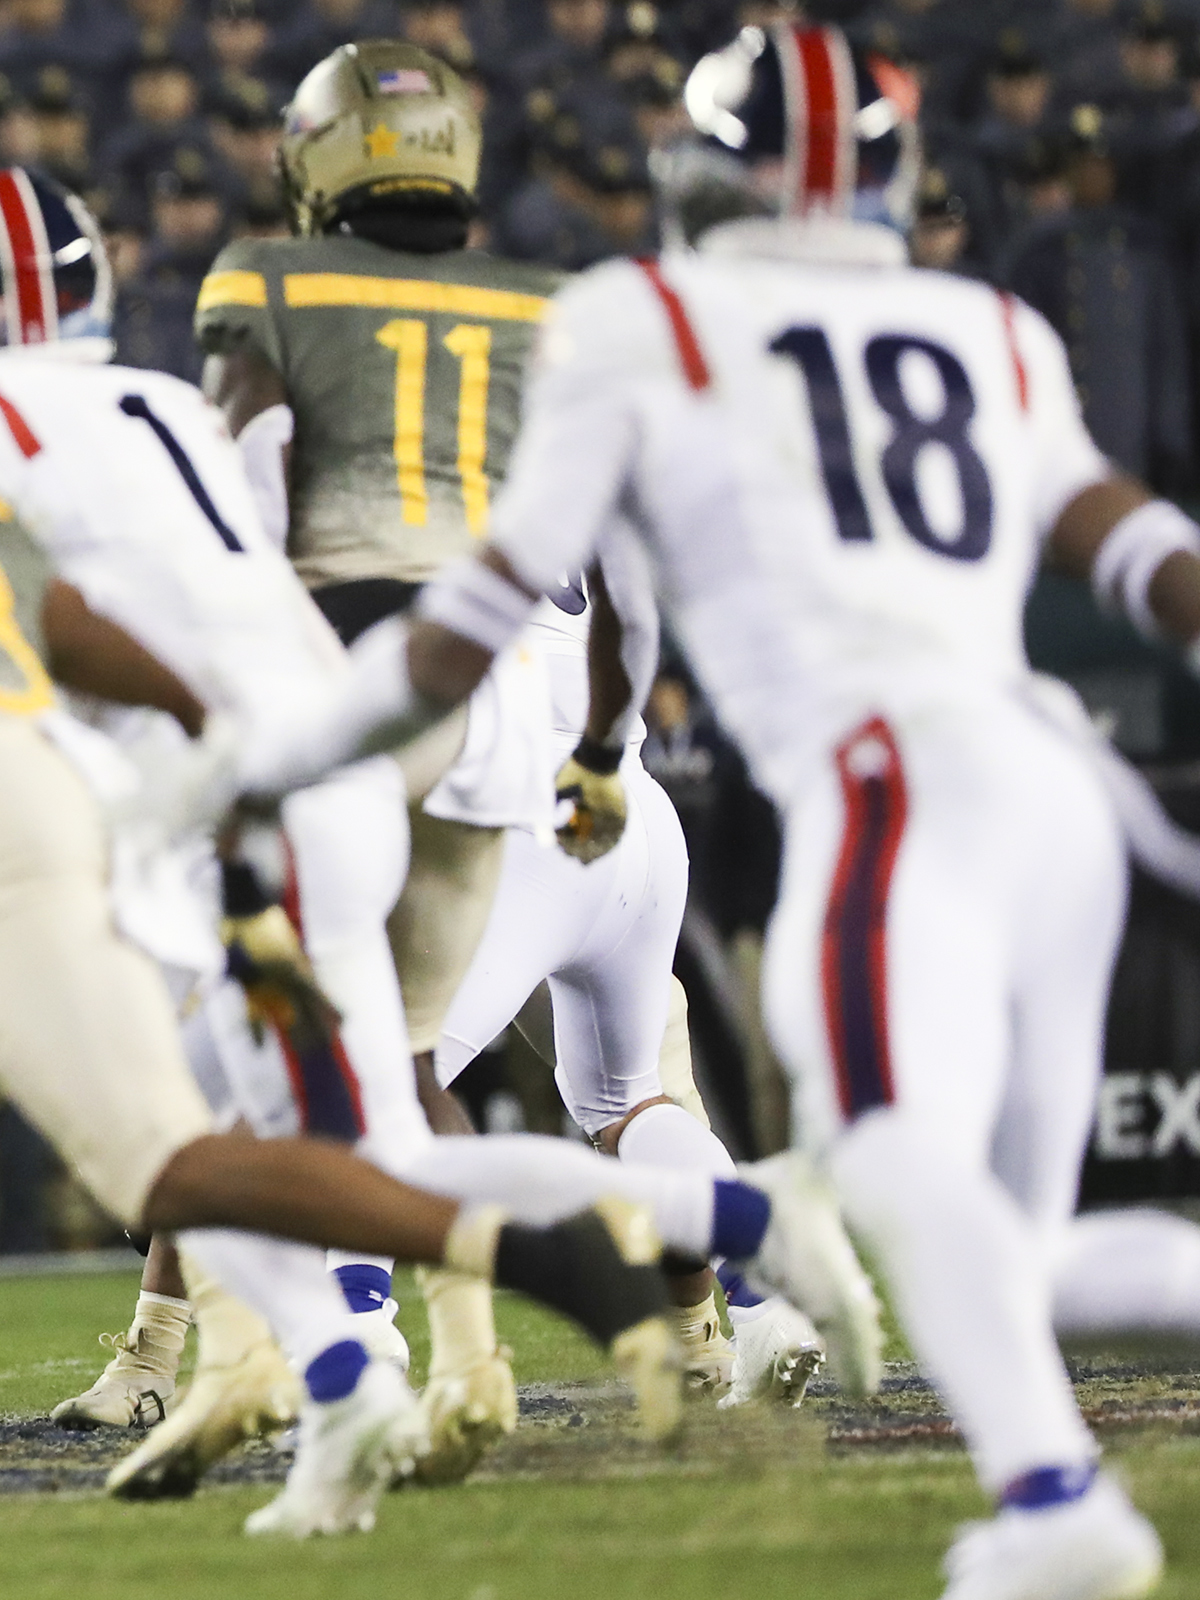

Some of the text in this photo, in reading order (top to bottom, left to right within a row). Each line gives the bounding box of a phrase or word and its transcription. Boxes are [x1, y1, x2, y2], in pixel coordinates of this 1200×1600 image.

[116, 393, 246, 554] 1
[376, 318, 492, 538] 11
[768, 323, 996, 563] 18
